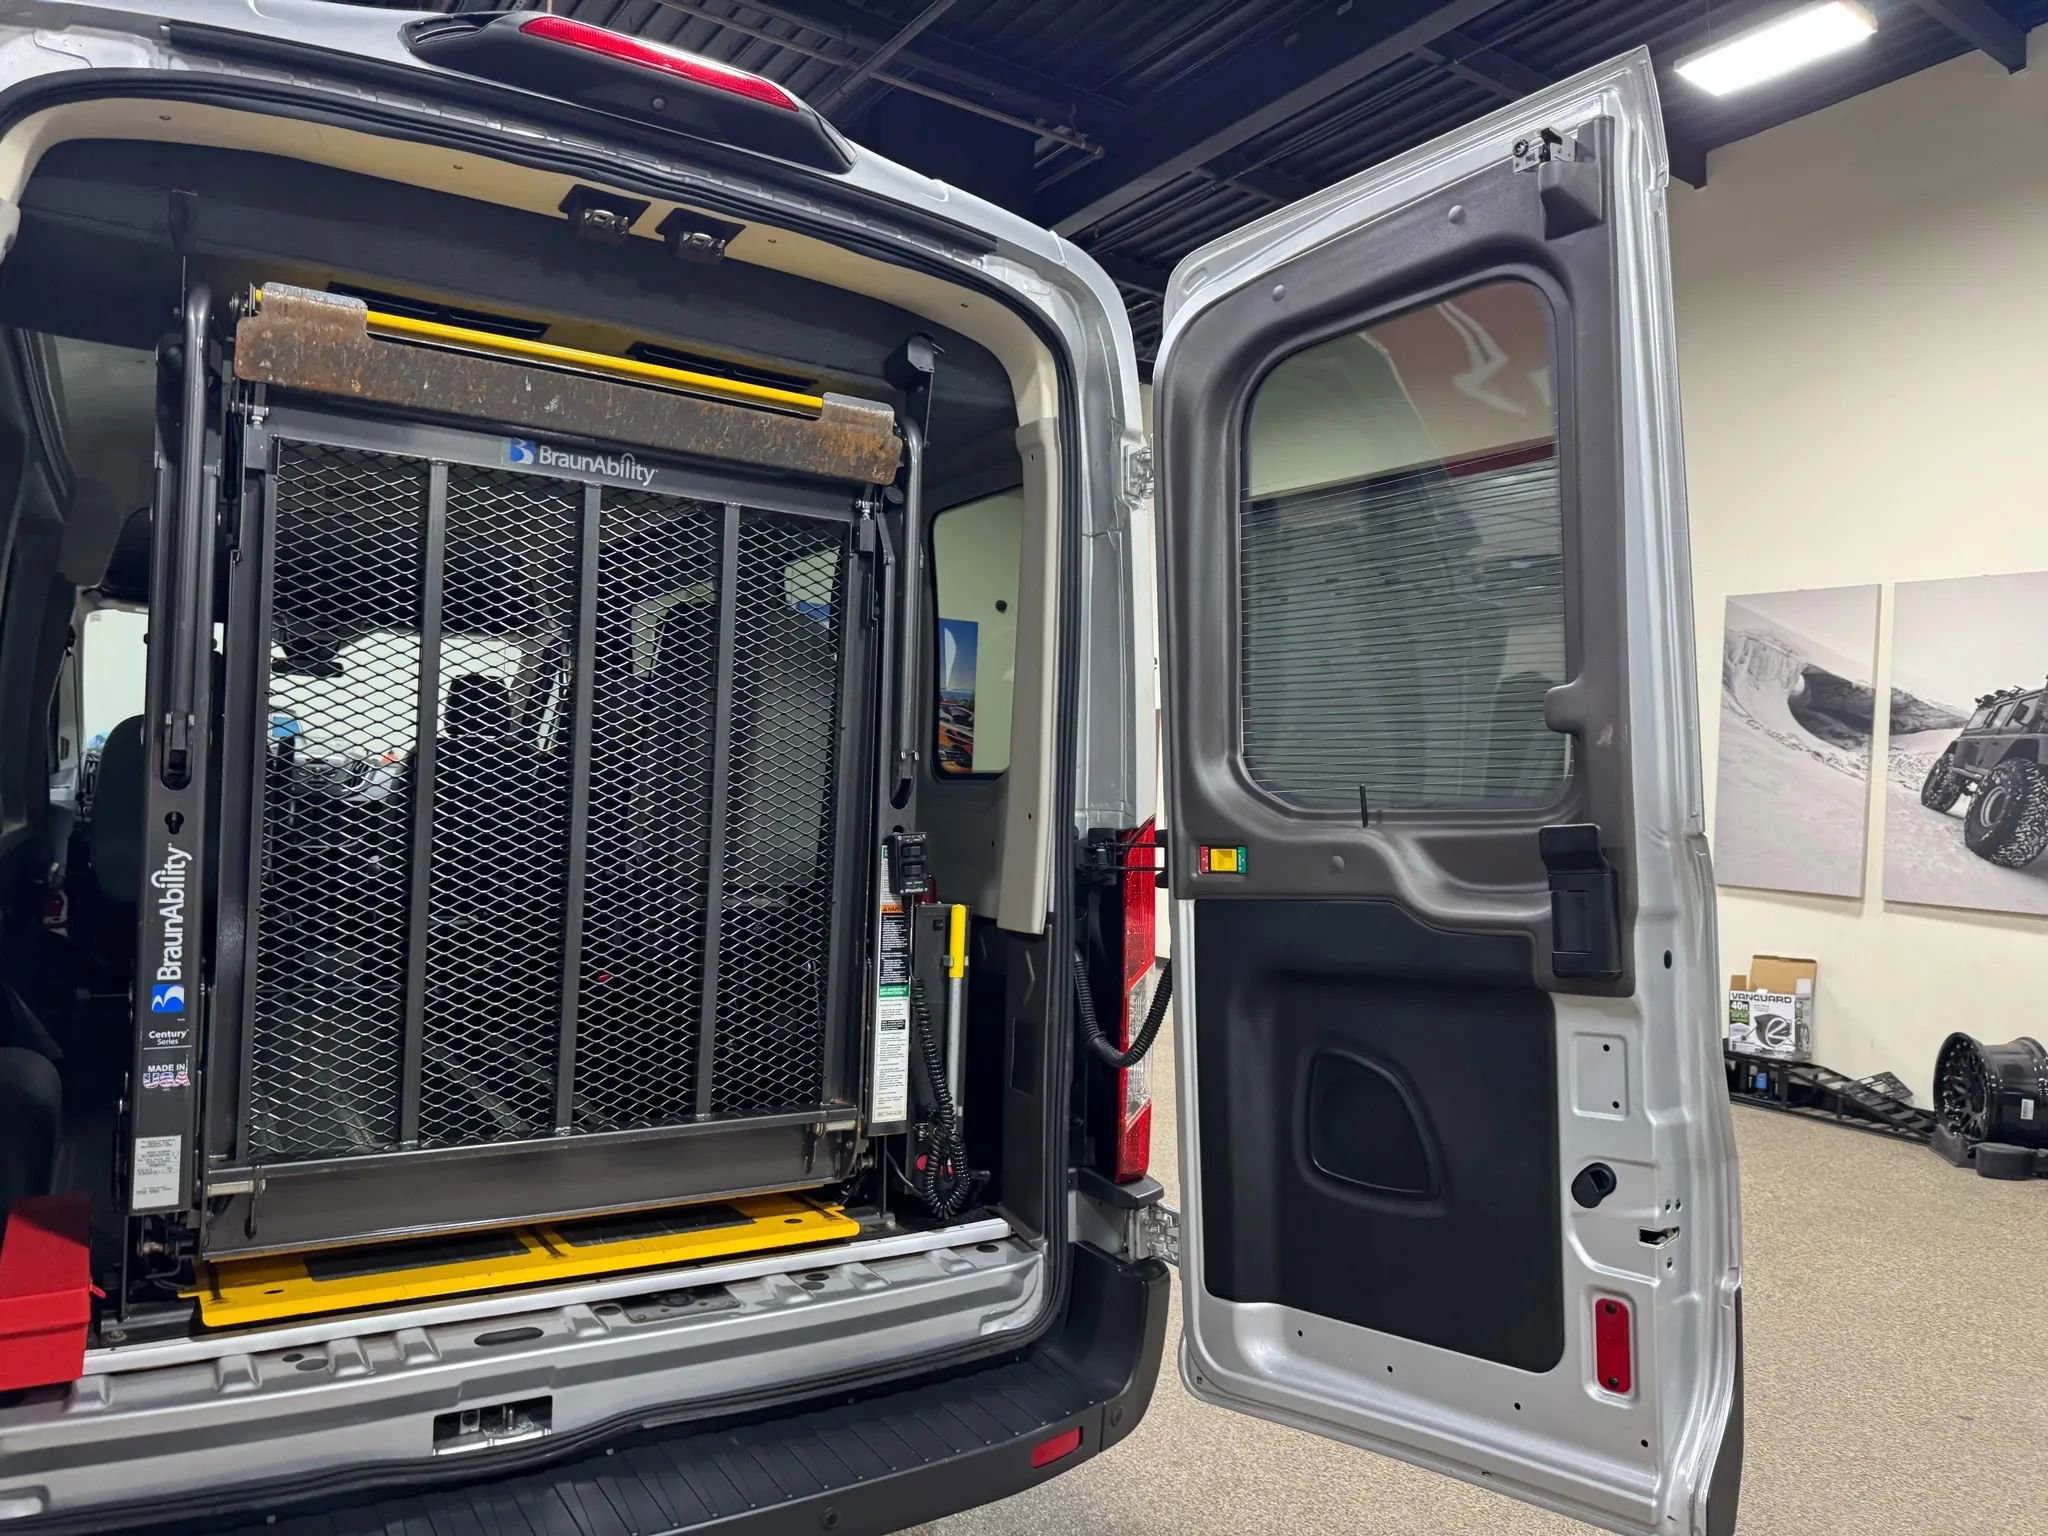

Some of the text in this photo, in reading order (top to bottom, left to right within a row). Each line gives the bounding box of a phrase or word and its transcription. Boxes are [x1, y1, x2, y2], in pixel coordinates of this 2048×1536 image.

[539, 445, 656, 486] BraunAbility
[151, 845, 193, 981] BraunAbility
[1732, 992, 1792, 1004] VANGUARD
[148, 1030, 187, 1039] Century
[148, 1063, 186, 1073] MADE IN
[143, 1071, 191, 1088] USA
